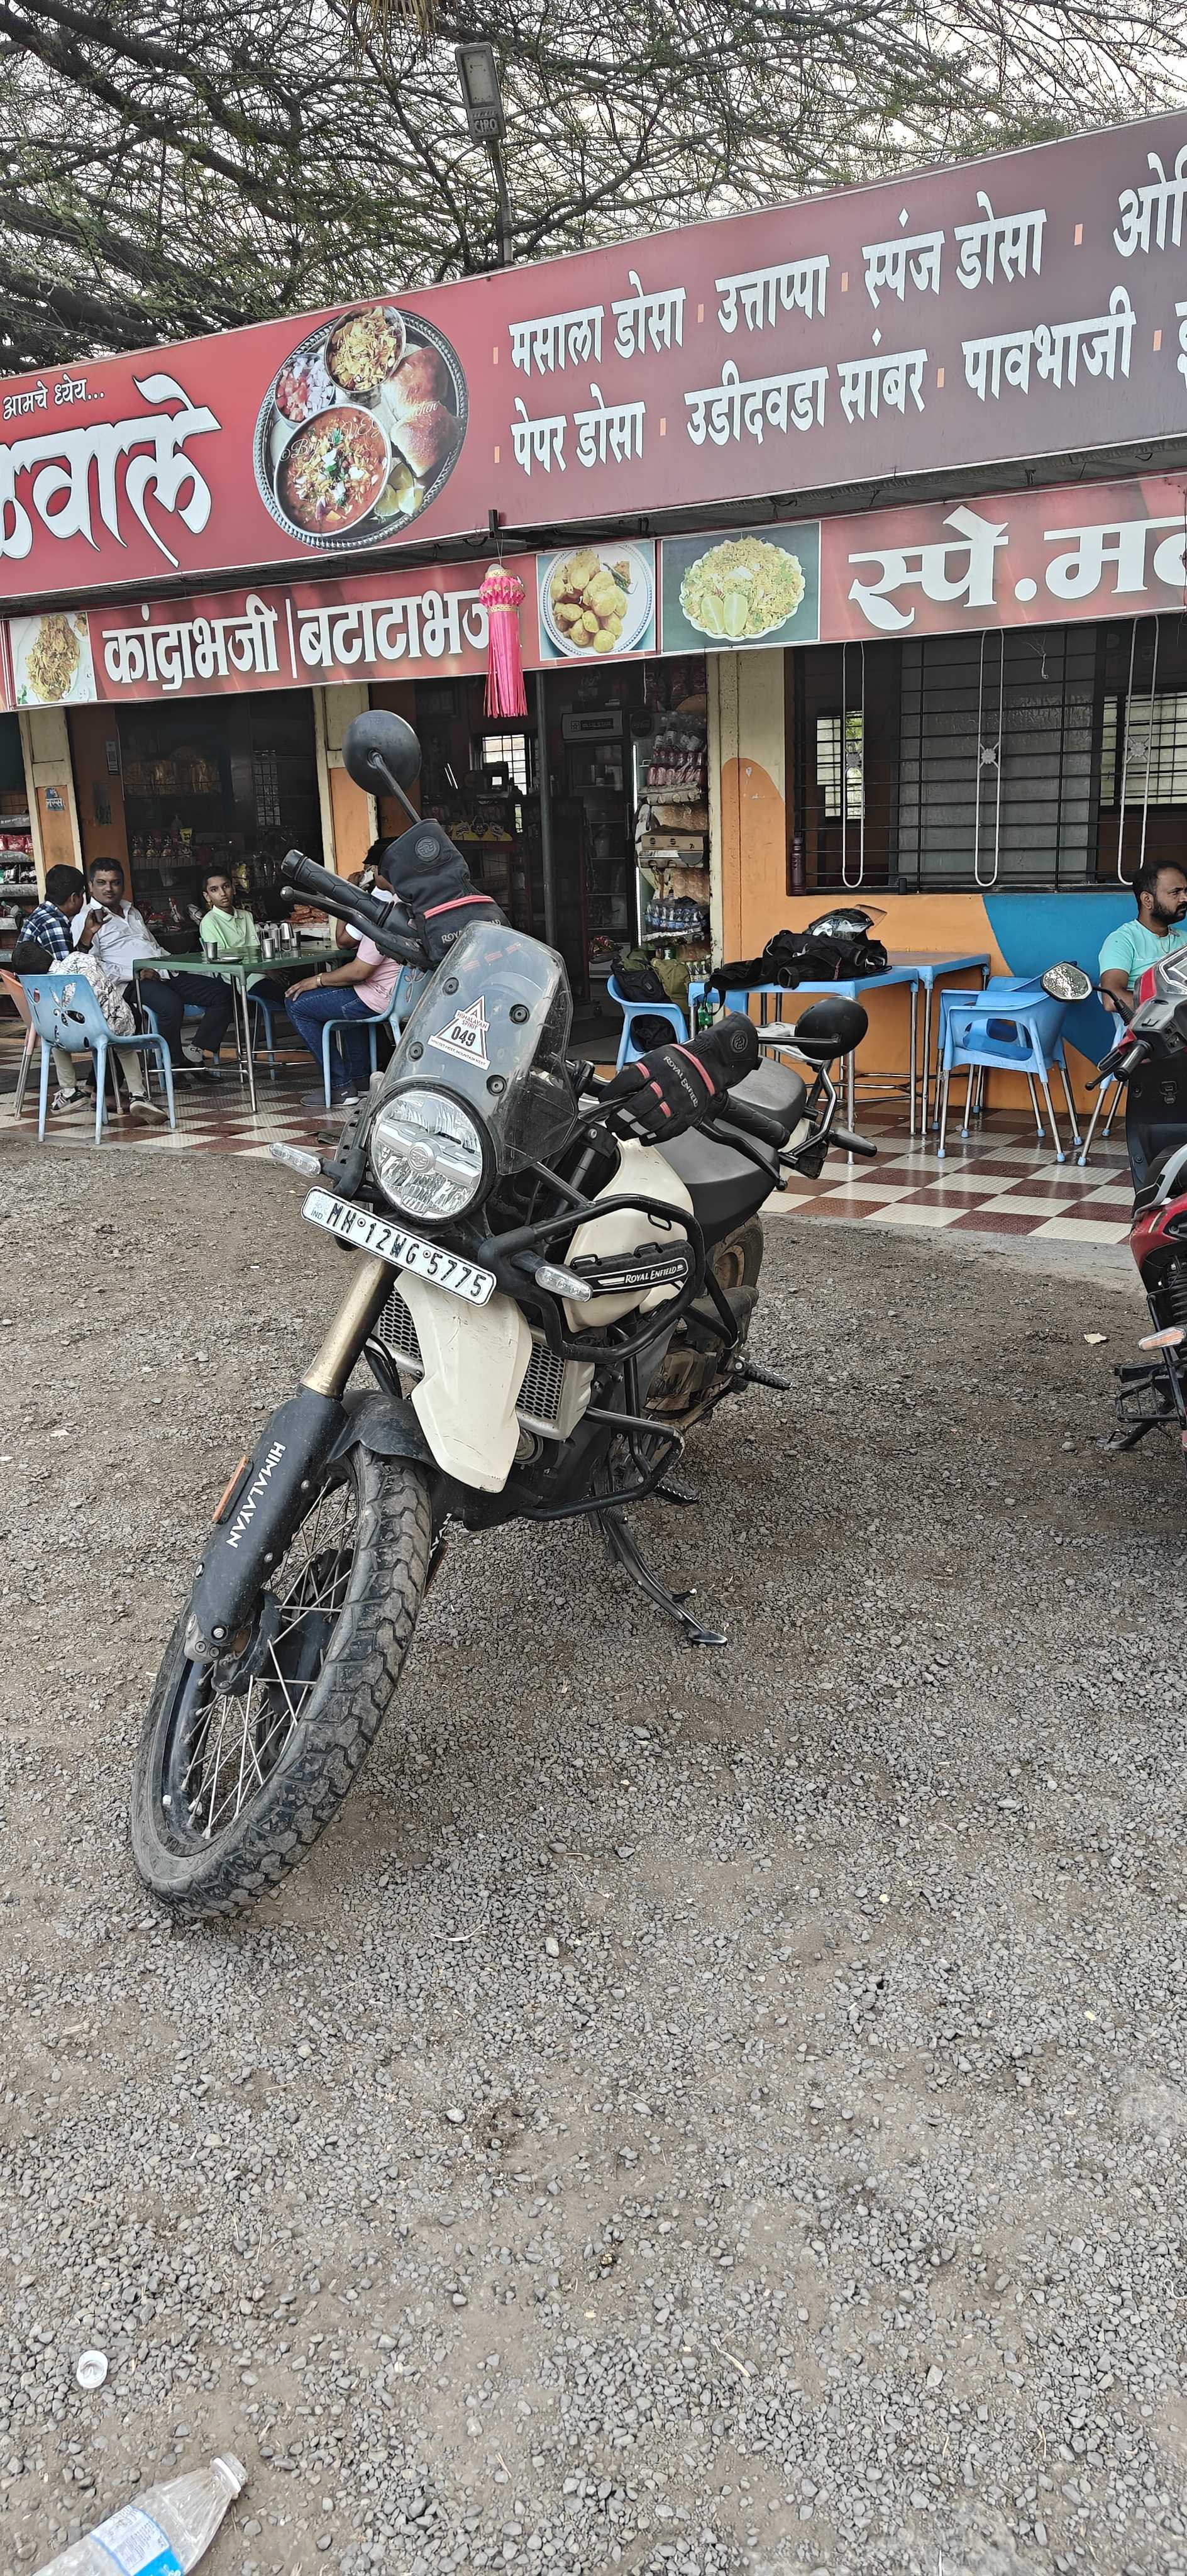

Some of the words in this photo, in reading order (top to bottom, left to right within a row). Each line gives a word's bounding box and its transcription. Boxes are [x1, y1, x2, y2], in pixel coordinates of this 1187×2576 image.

[861, 208, 945, 309] स्पंज
[953, 190, 1047, 291] डोसा
[715, 254, 831, 334] उत्ताप्पा
[508, 304, 605, 377] मसाला
[610, 269, 687, 359] डोसा
[961, 285, 1137, 402] पावभाजी
[3, 380, 48, 420] आमचे
[684, 358, 829, 447] उडीदवडा
[837, 326, 929, 425] सांबर
[510, 396, 567, 477] पेपर
[573, 382, 647, 469] डोसा
[102, 593, 280, 691] कांदाभजी
[297, 588, 490, 667] बटाटाभज
[441, 930, 463, 943] ROYA
[451, 1026, 476, 1047] 049
[457, 1011, 487, 1029] HIMALAYAN
[461, 1019, 478, 1030] SPIRIT
[663, 1056, 683, 1080] ROYAL
[681, 1077, 699, 1108] ENFIELD
[311, 1209, 323, 1220] IND
[425, 1253, 488, 1297] 5775
[625, 1274, 649, 1284] ROYAL
[650, 1266, 677, 1280] ENFIELD
[226, 1440, 287, 1549] HIMALAYAN
